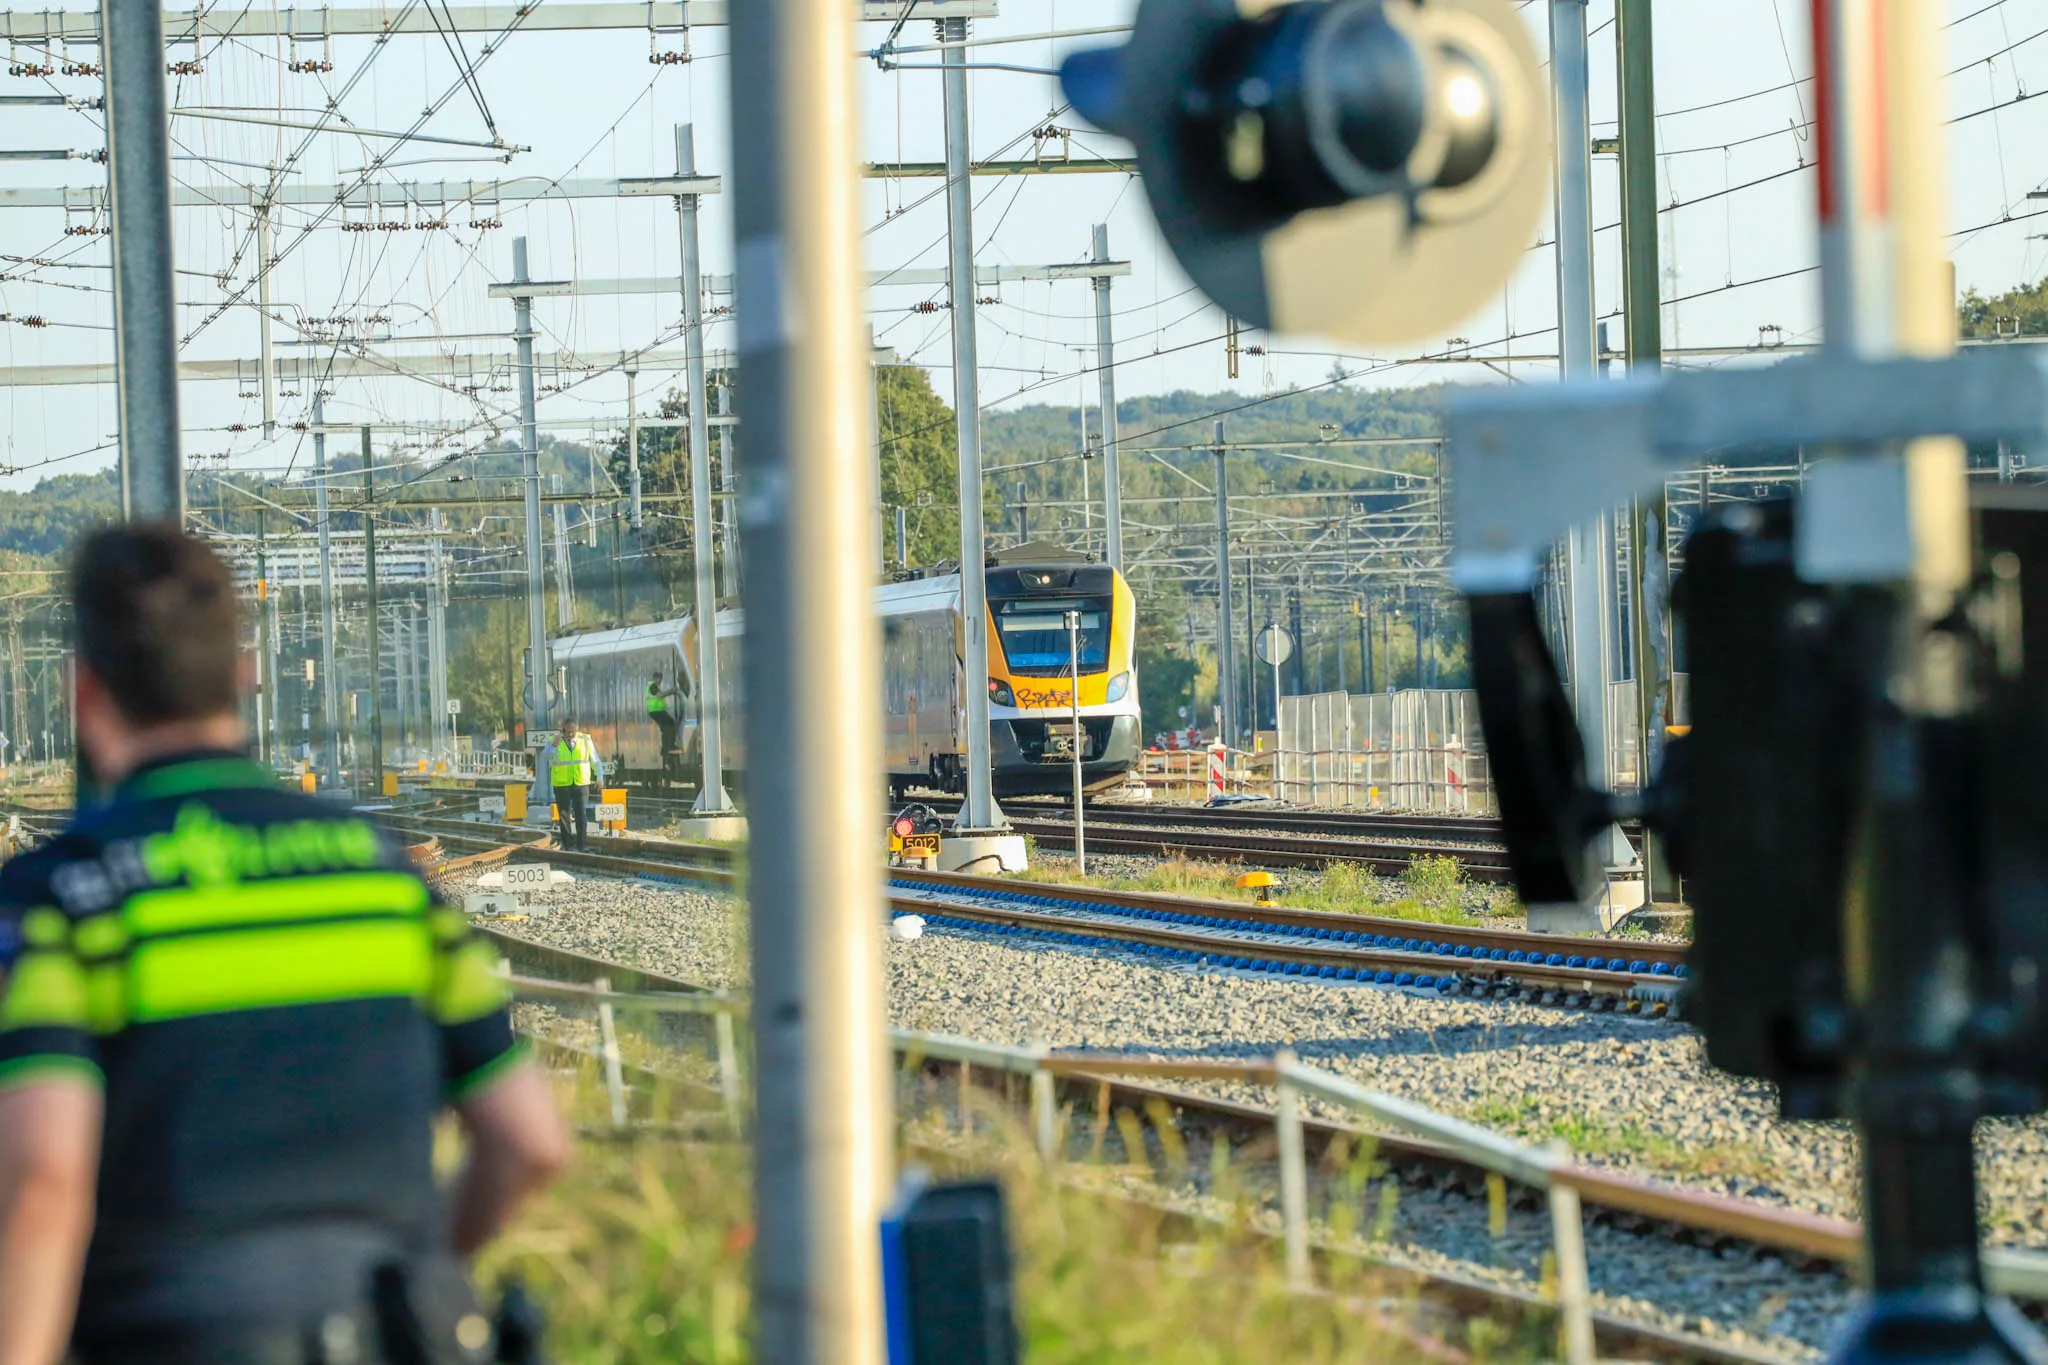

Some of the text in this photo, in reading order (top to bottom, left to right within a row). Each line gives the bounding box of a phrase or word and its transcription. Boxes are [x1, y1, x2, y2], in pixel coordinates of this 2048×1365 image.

[600, 807, 620, 816] 5013
[905, 837, 936, 851] 5012
[508, 868, 545, 884] 5003
